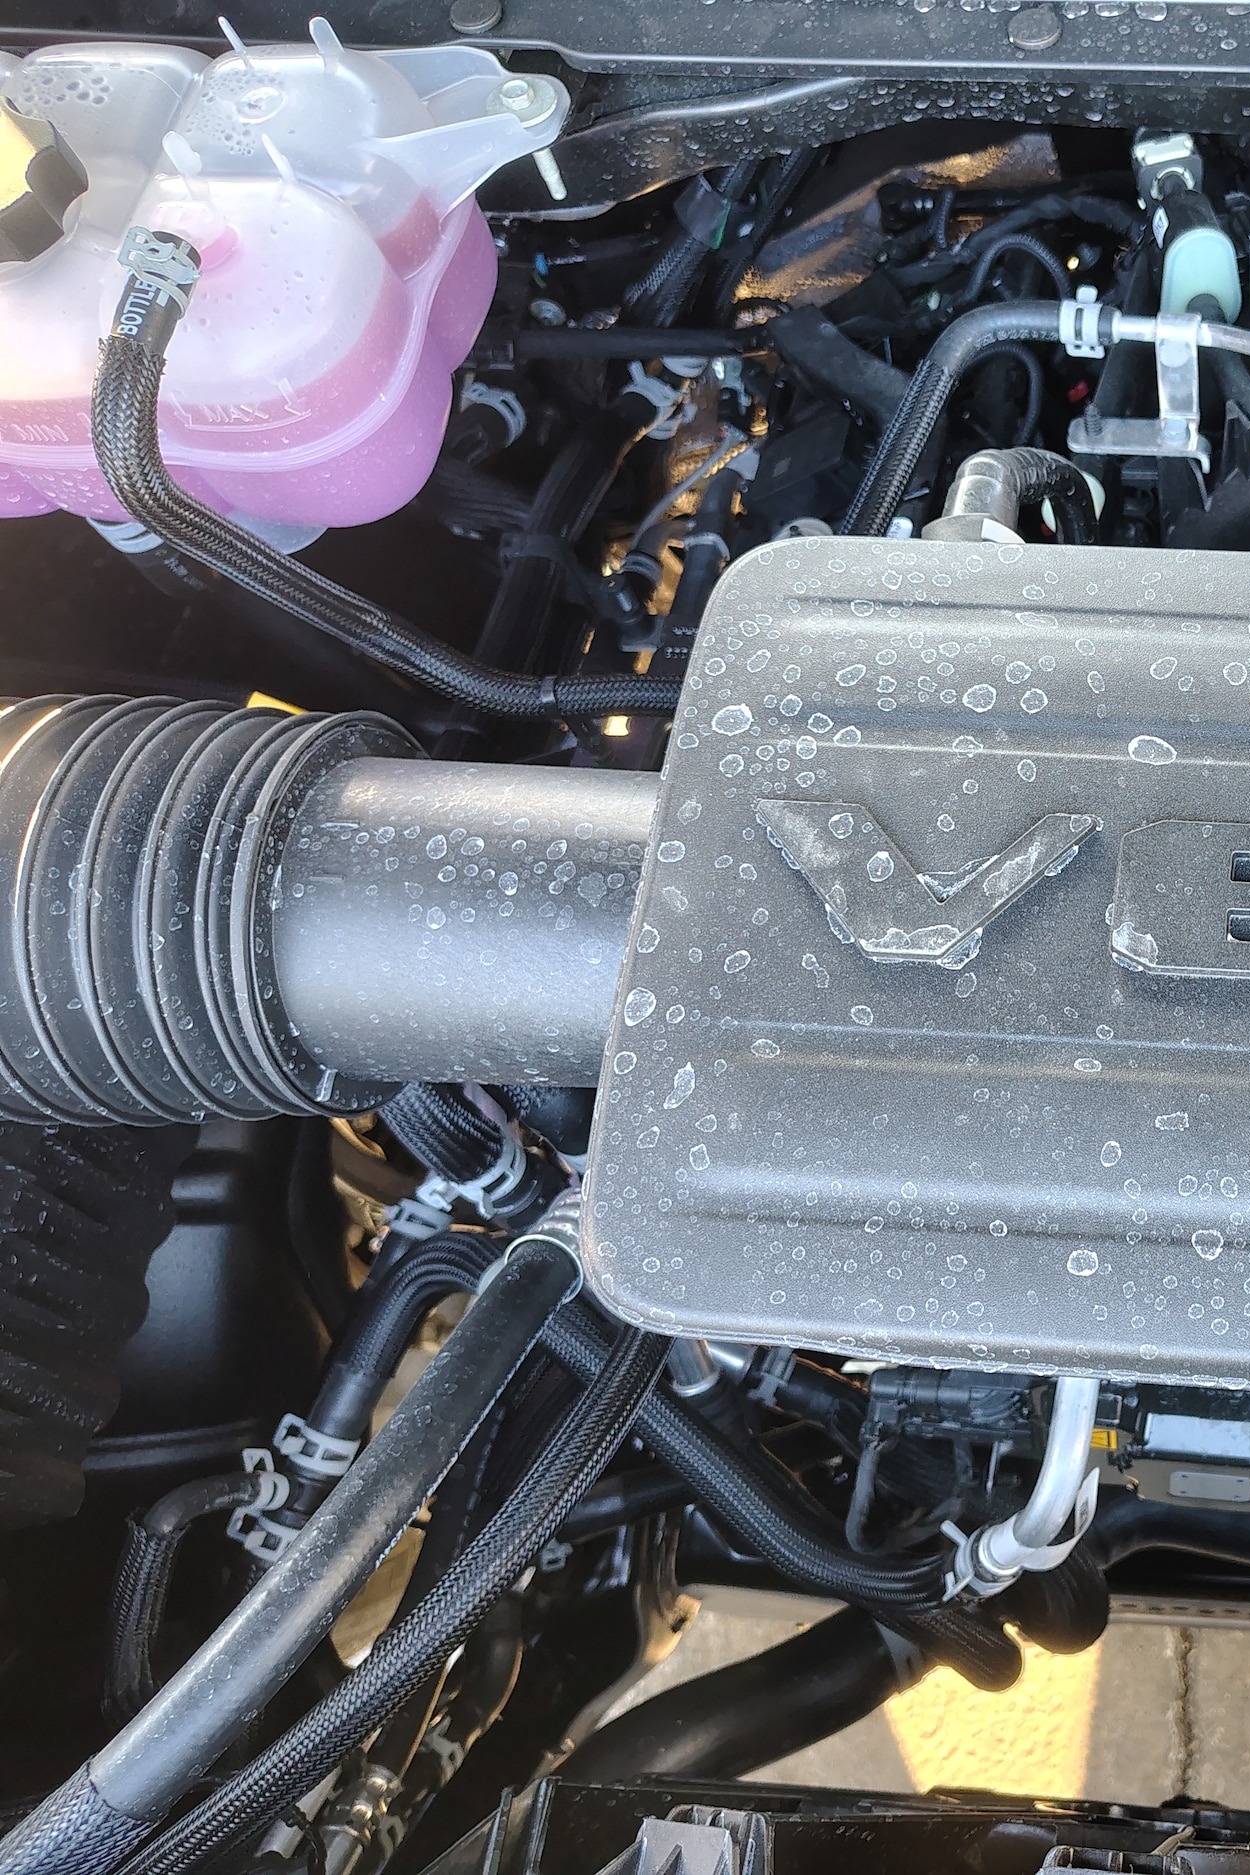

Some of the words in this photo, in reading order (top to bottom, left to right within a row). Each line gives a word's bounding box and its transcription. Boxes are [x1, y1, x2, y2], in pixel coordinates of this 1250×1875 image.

[117, 280, 157, 336] BOTTLE
[201, 402, 269, 423] MAX
[12, 424, 69, 443] MIN
